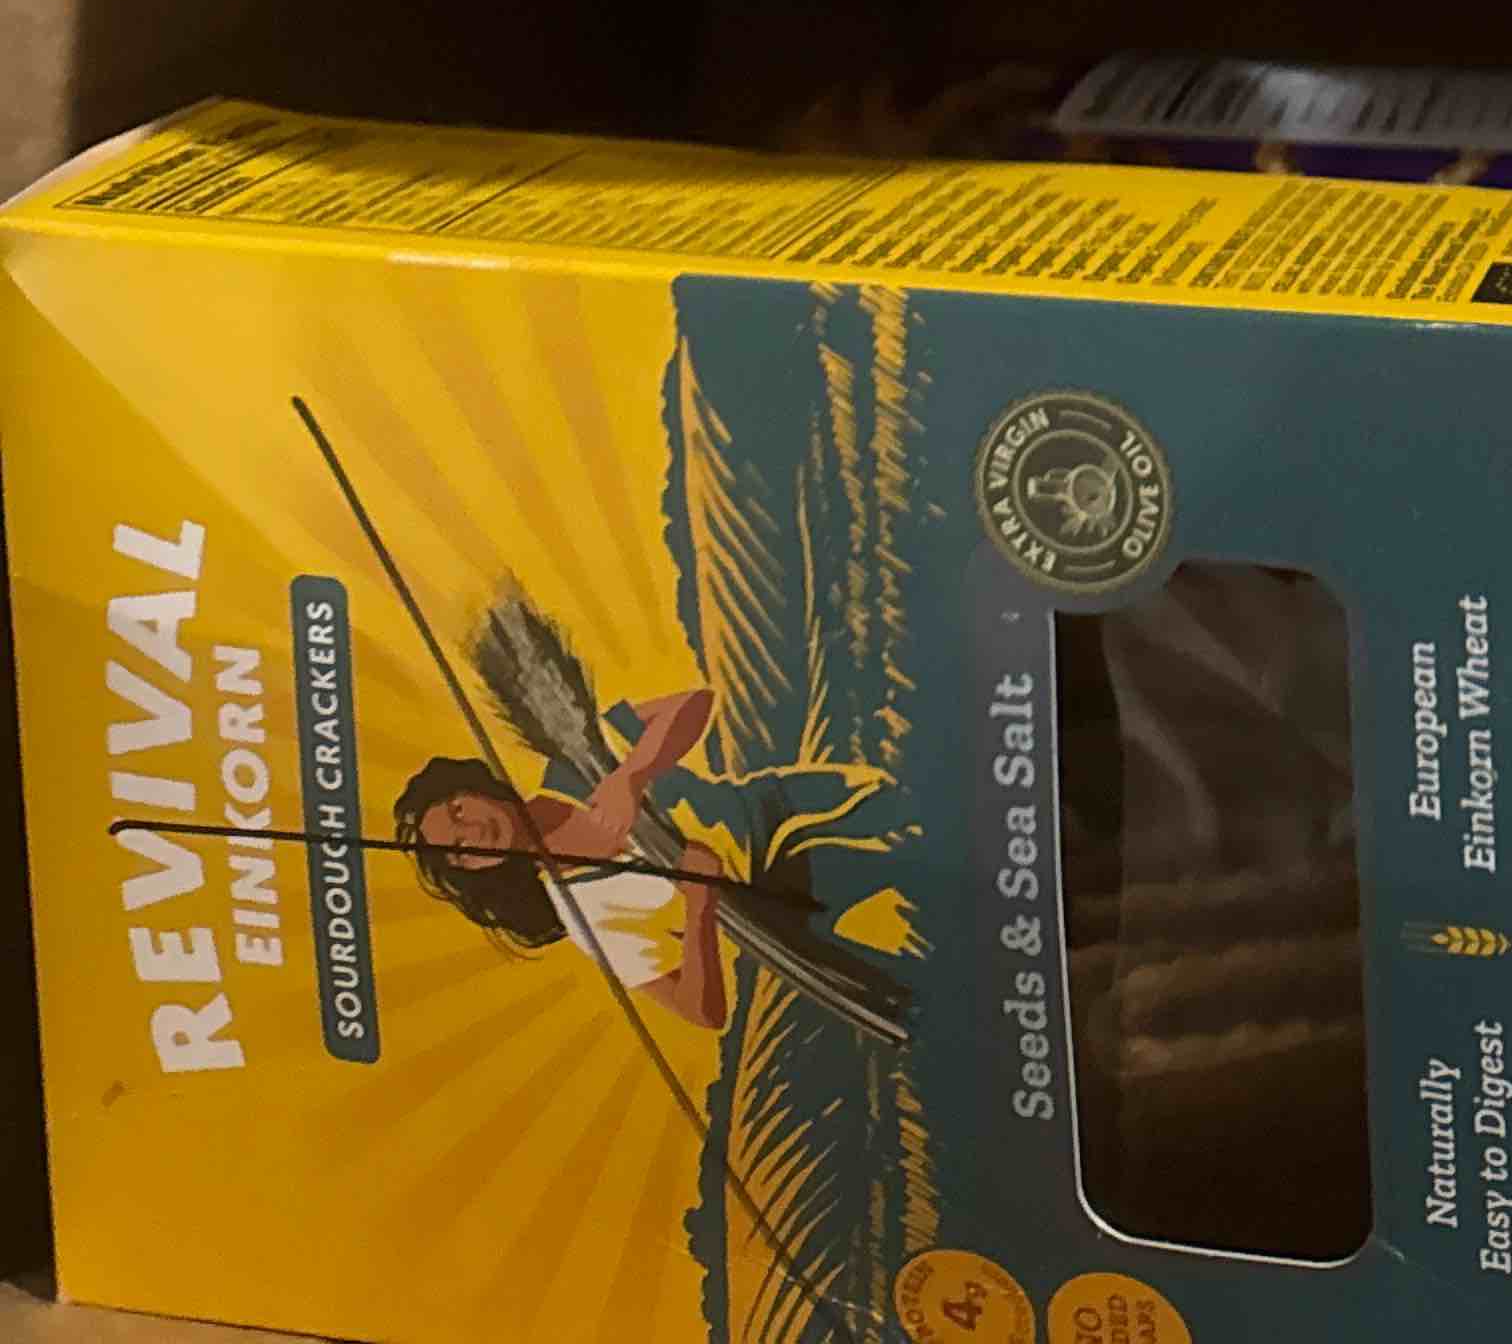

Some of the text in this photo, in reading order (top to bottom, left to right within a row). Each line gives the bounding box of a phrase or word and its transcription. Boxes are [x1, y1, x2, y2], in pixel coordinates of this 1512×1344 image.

[988, 407, 1057, 571] EXTRA VIRGIN
[1119, 429, 1160, 558] OLIVE OIL
[104, 518, 245, 1072] REVIVAL
[213, 644, 283, 967] EINKORN
[306, 600, 365, 1038] SOURDOUGH CRACKERS
[1409, 640, 1447, 818] European
[1459, 594, 1498, 871] Einkorn Wheat
[990, 670, 1055, 1119] Seeds & Sea Salt
[1421, 1057, 1461, 1228] Naturally
[1480, 1146, 1509, 1181] to
